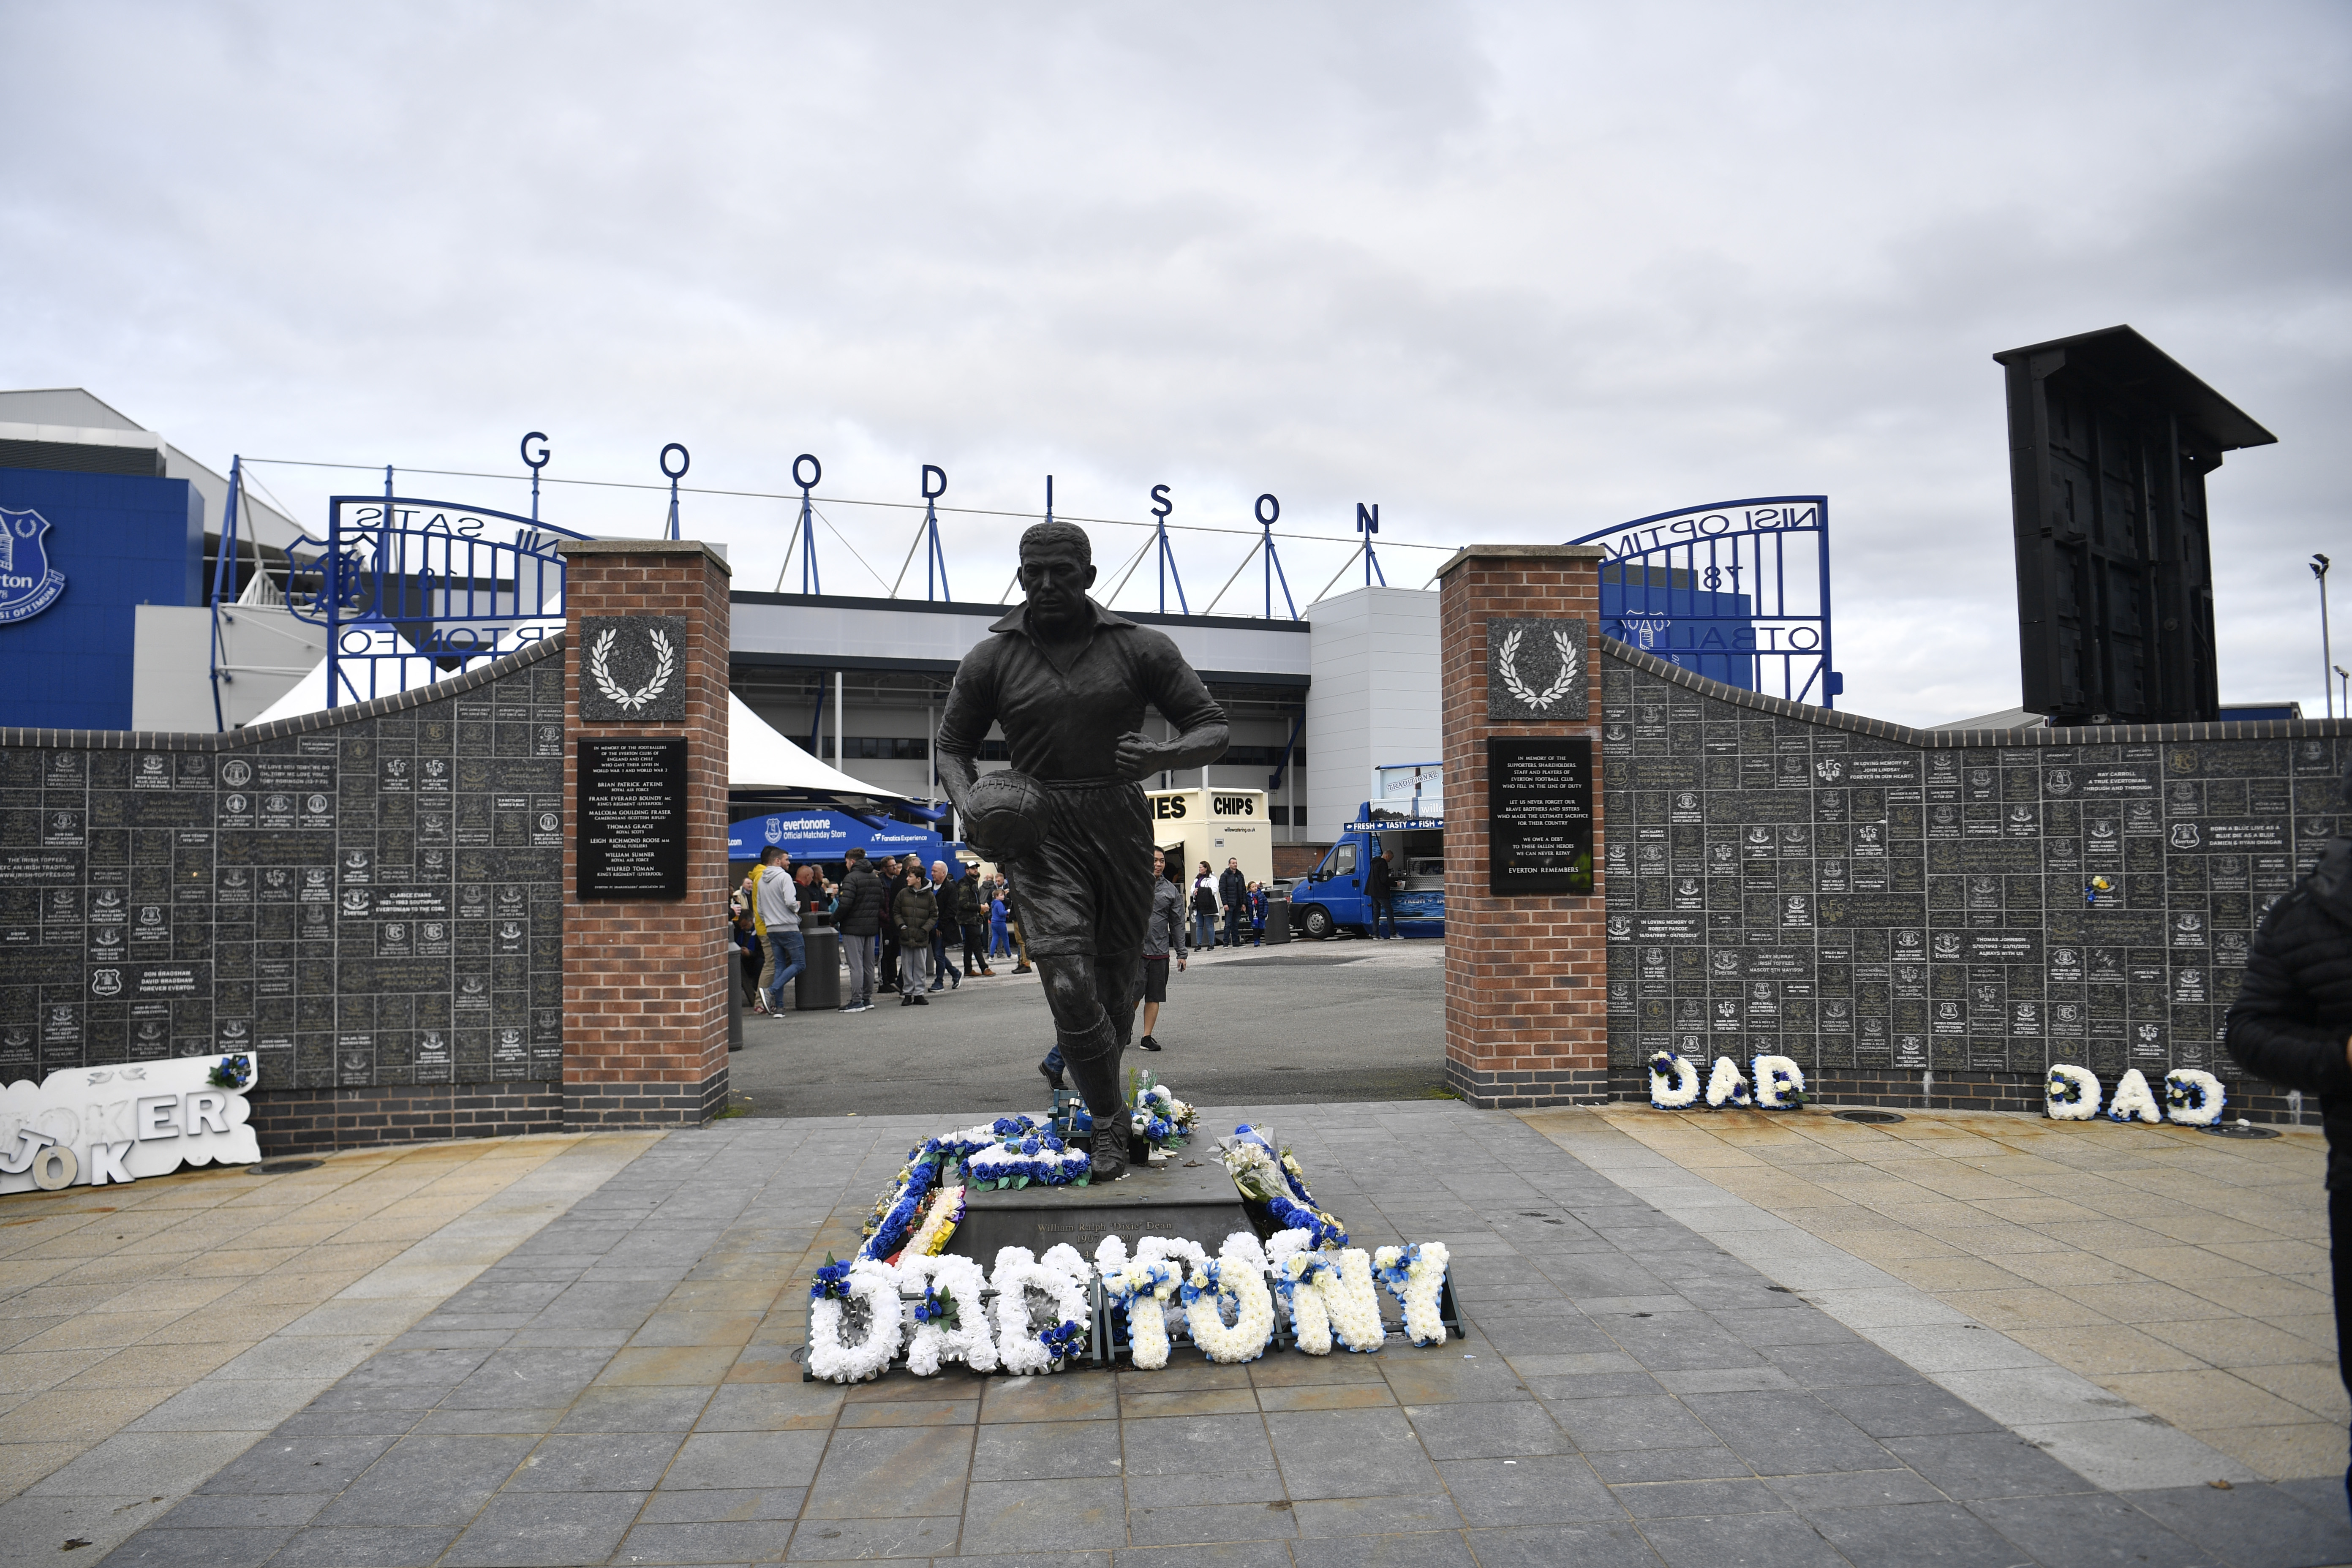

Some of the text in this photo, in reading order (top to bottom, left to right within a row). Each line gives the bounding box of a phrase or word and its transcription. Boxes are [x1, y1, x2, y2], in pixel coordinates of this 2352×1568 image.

[521, 431, 1379, 533] GOODISON
[13, 586, 56, 618] OPTIMUM
[1387, 770, 1439, 792] TRADITIONAL
[1149, 796, 1186, 819] IES
[1214, 797, 1253, 815] CHIPS
[783, 818, 830, 830] evertonone
[783, 830, 847, 840] Official Matchday Store
[1353, 820, 1435, 830] FRESH TASTY FISH
[1649, 1054, 1805, 1110] DAD
[2045, 1064, 2227, 1126] DAD
[1037, 1224, 1074, 1232] William
[1078, 1223, 1106, 1233] Ralph
[1146, 1222, 1172, 1230] Dean
[1077, 1234, 1132, 1243] 1907 80
[809, 1254, 1092, 1383] DAD
